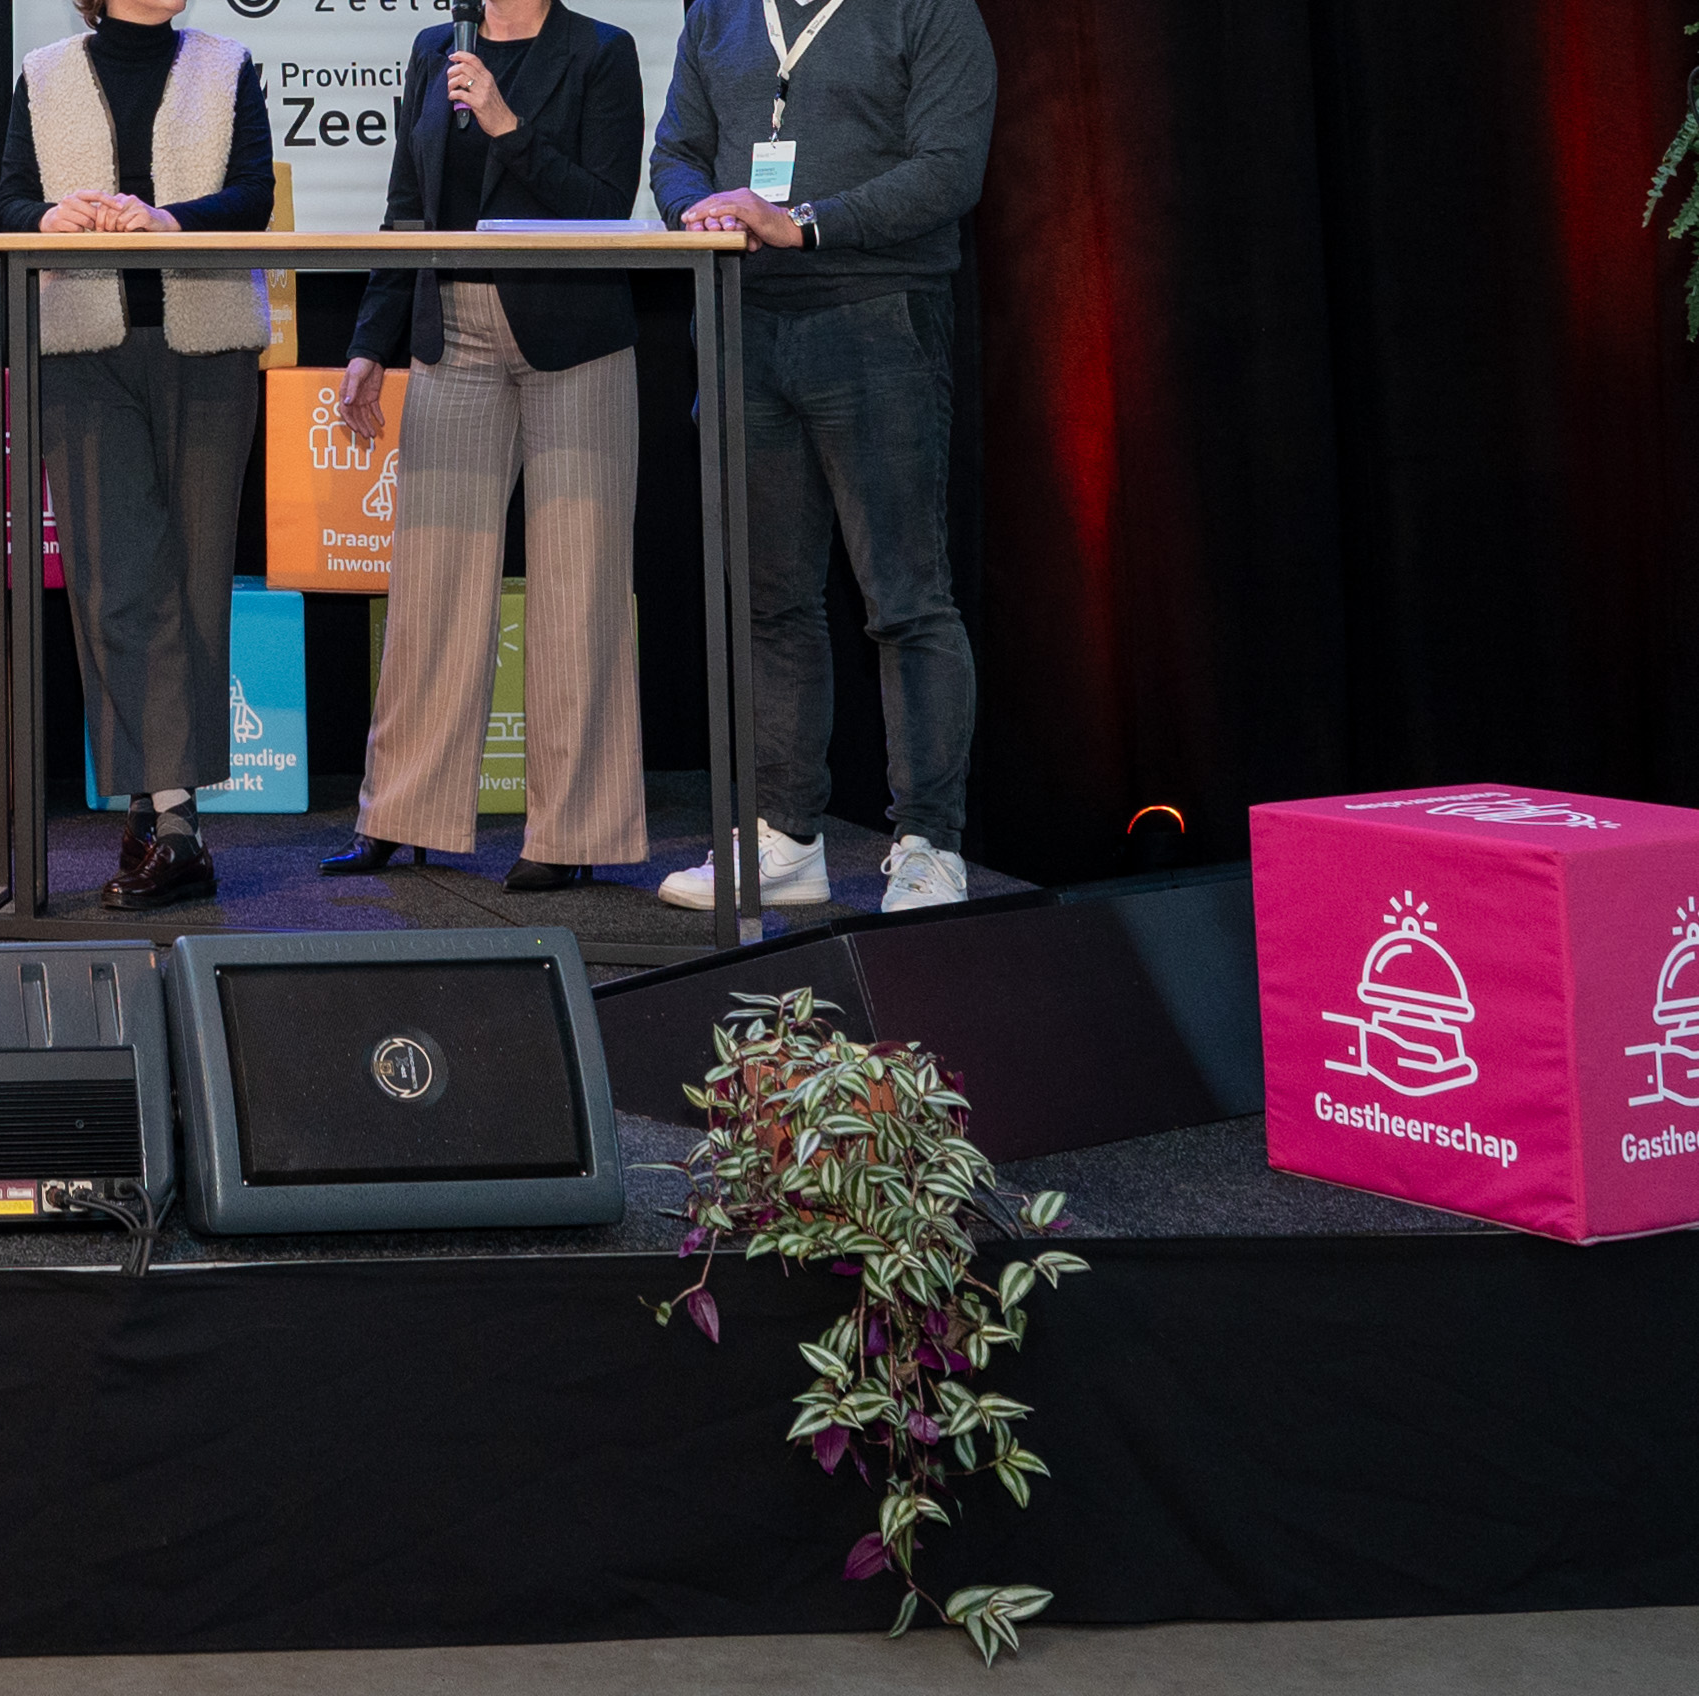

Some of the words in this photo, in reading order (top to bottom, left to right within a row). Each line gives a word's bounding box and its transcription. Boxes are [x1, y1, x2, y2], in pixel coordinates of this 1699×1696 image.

[280, 61, 404, 88] Provinci
[283, 97, 400, 146] Zeel
[1314, 1091, 1518, 1167] Gastheerschap
[1622, 1125, 1699, 1163] Gasthe
